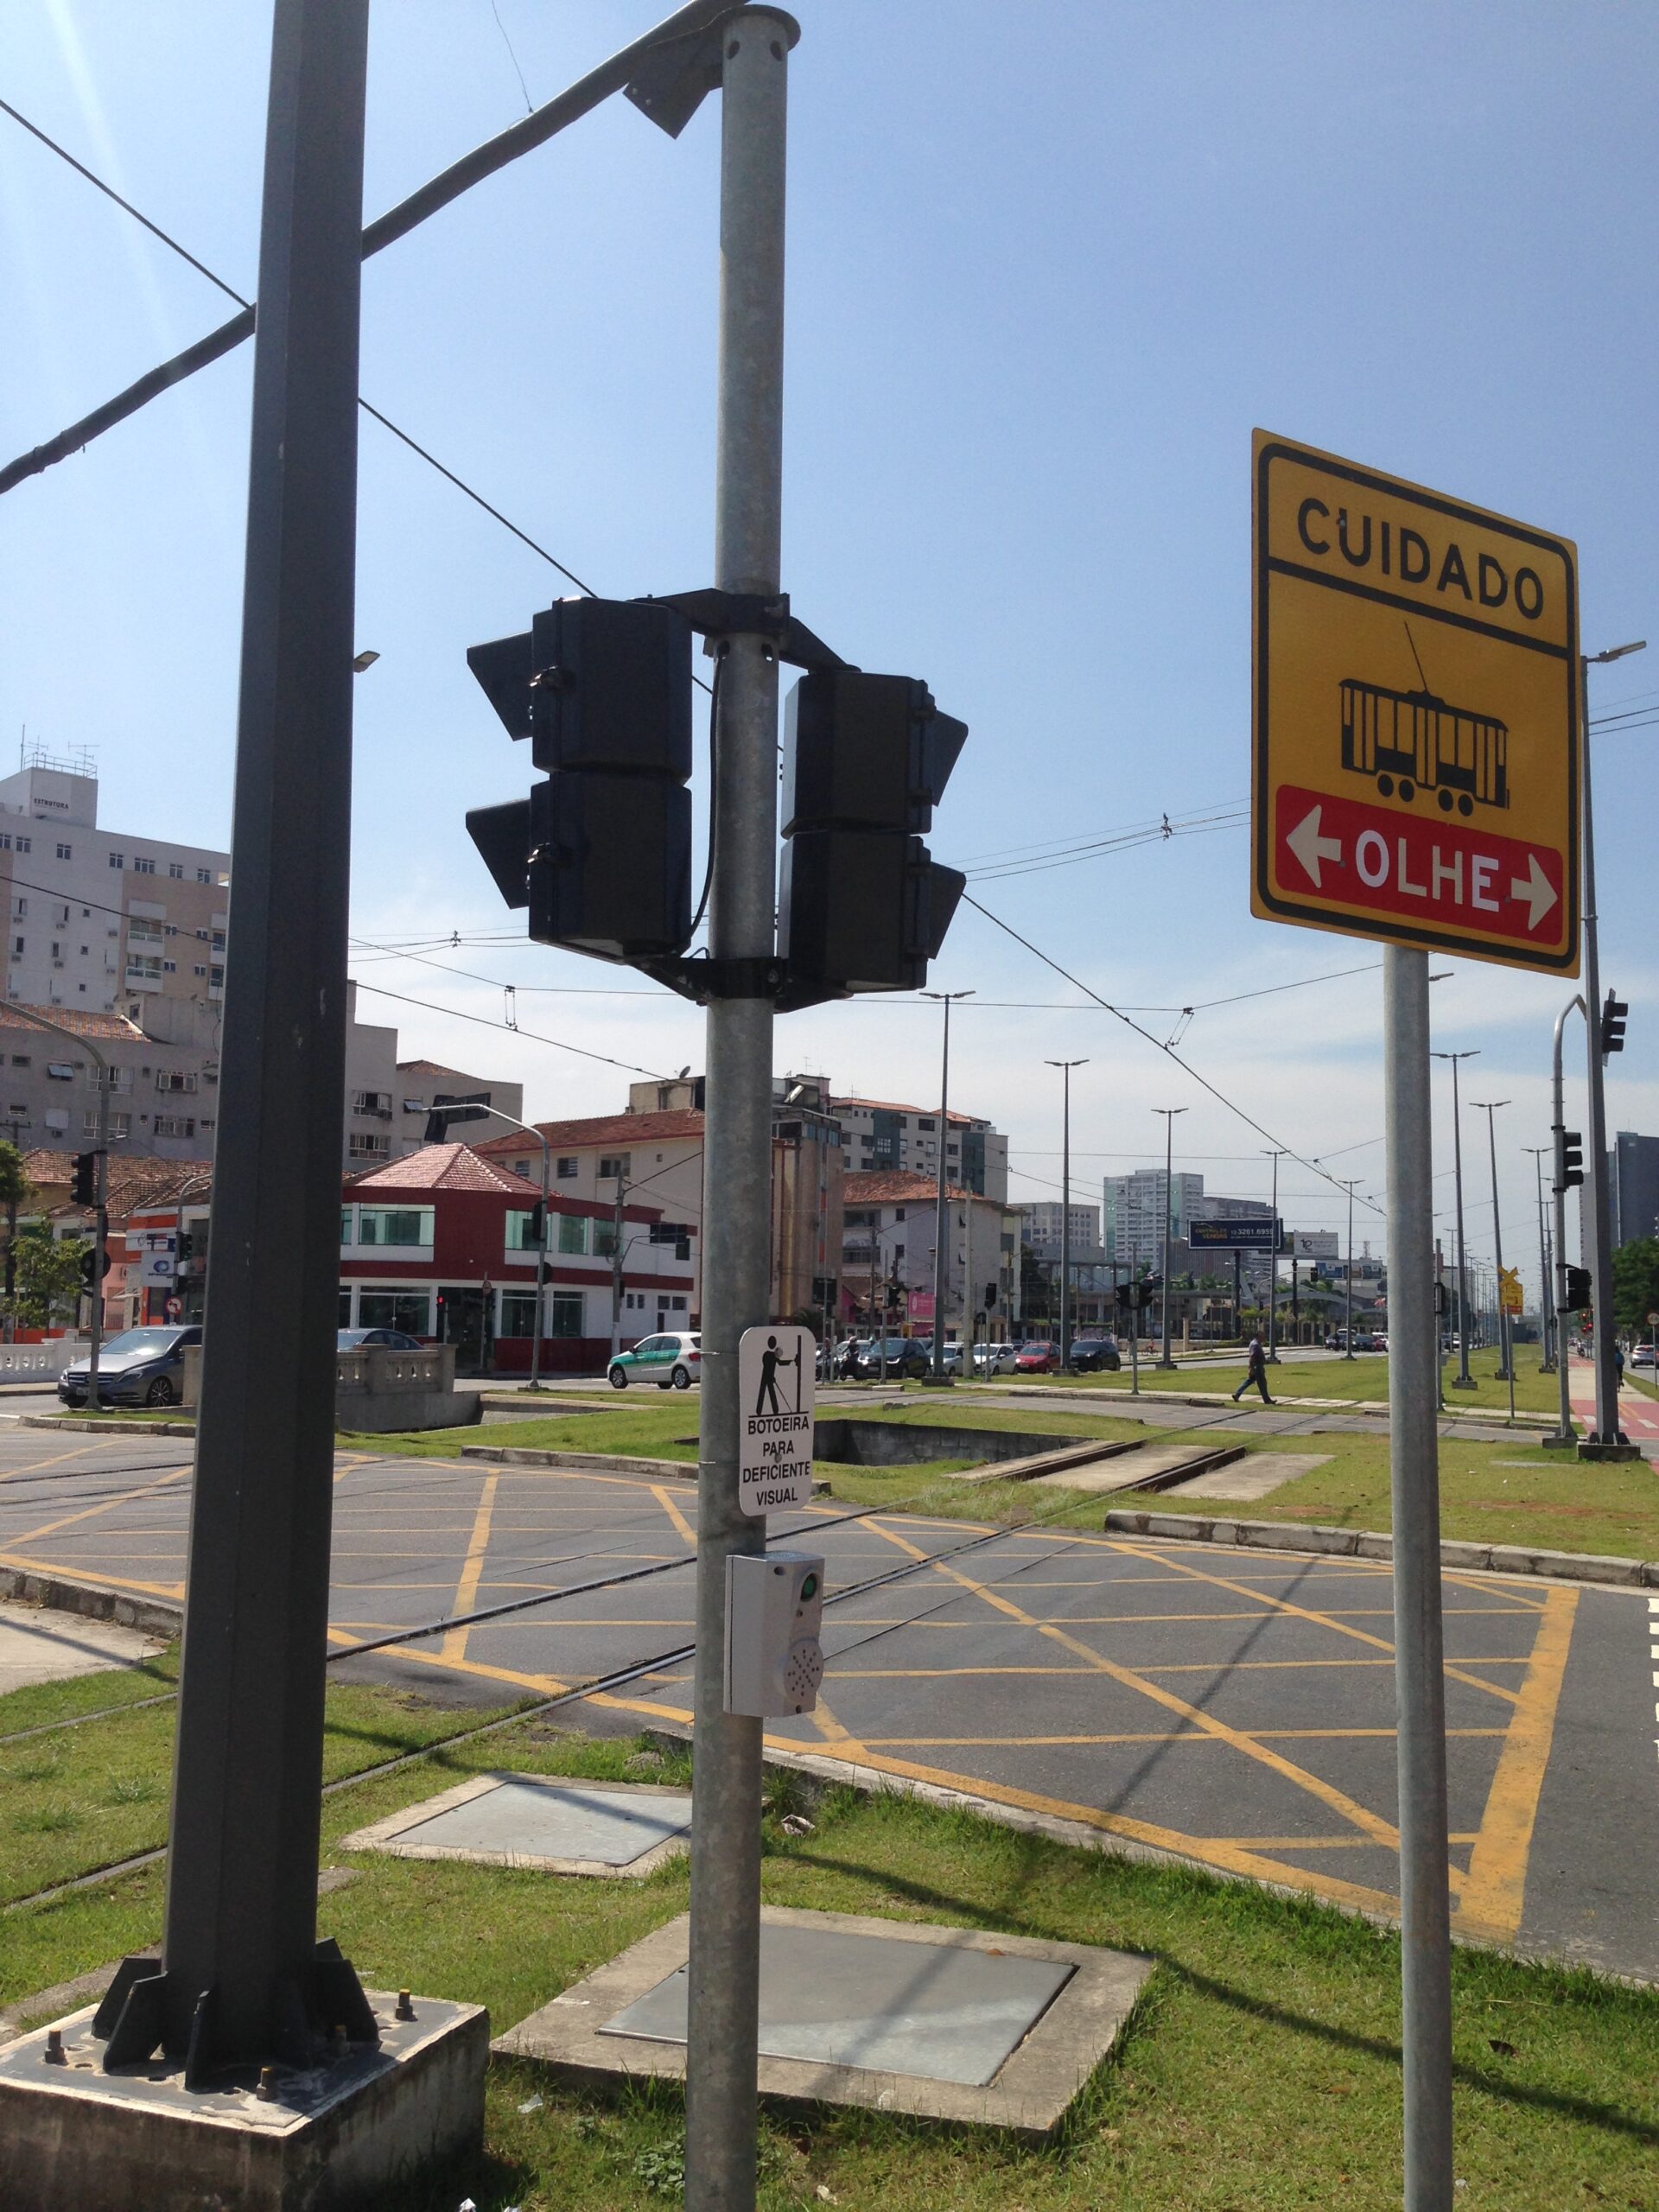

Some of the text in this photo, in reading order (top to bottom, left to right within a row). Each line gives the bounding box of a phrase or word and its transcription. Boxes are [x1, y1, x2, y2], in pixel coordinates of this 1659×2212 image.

[1298, 497, 1544, 620] CUIDADO
[1355, 830, 1500, 912] OLHE
[748, 1416, 810, 1435] BOTOEIRA
[763, 1440, 794, 1457] PARA
[743, 1461, 810, 1484] DEFICIENTE
[756, 1487, 798, 1506] VISUAL
